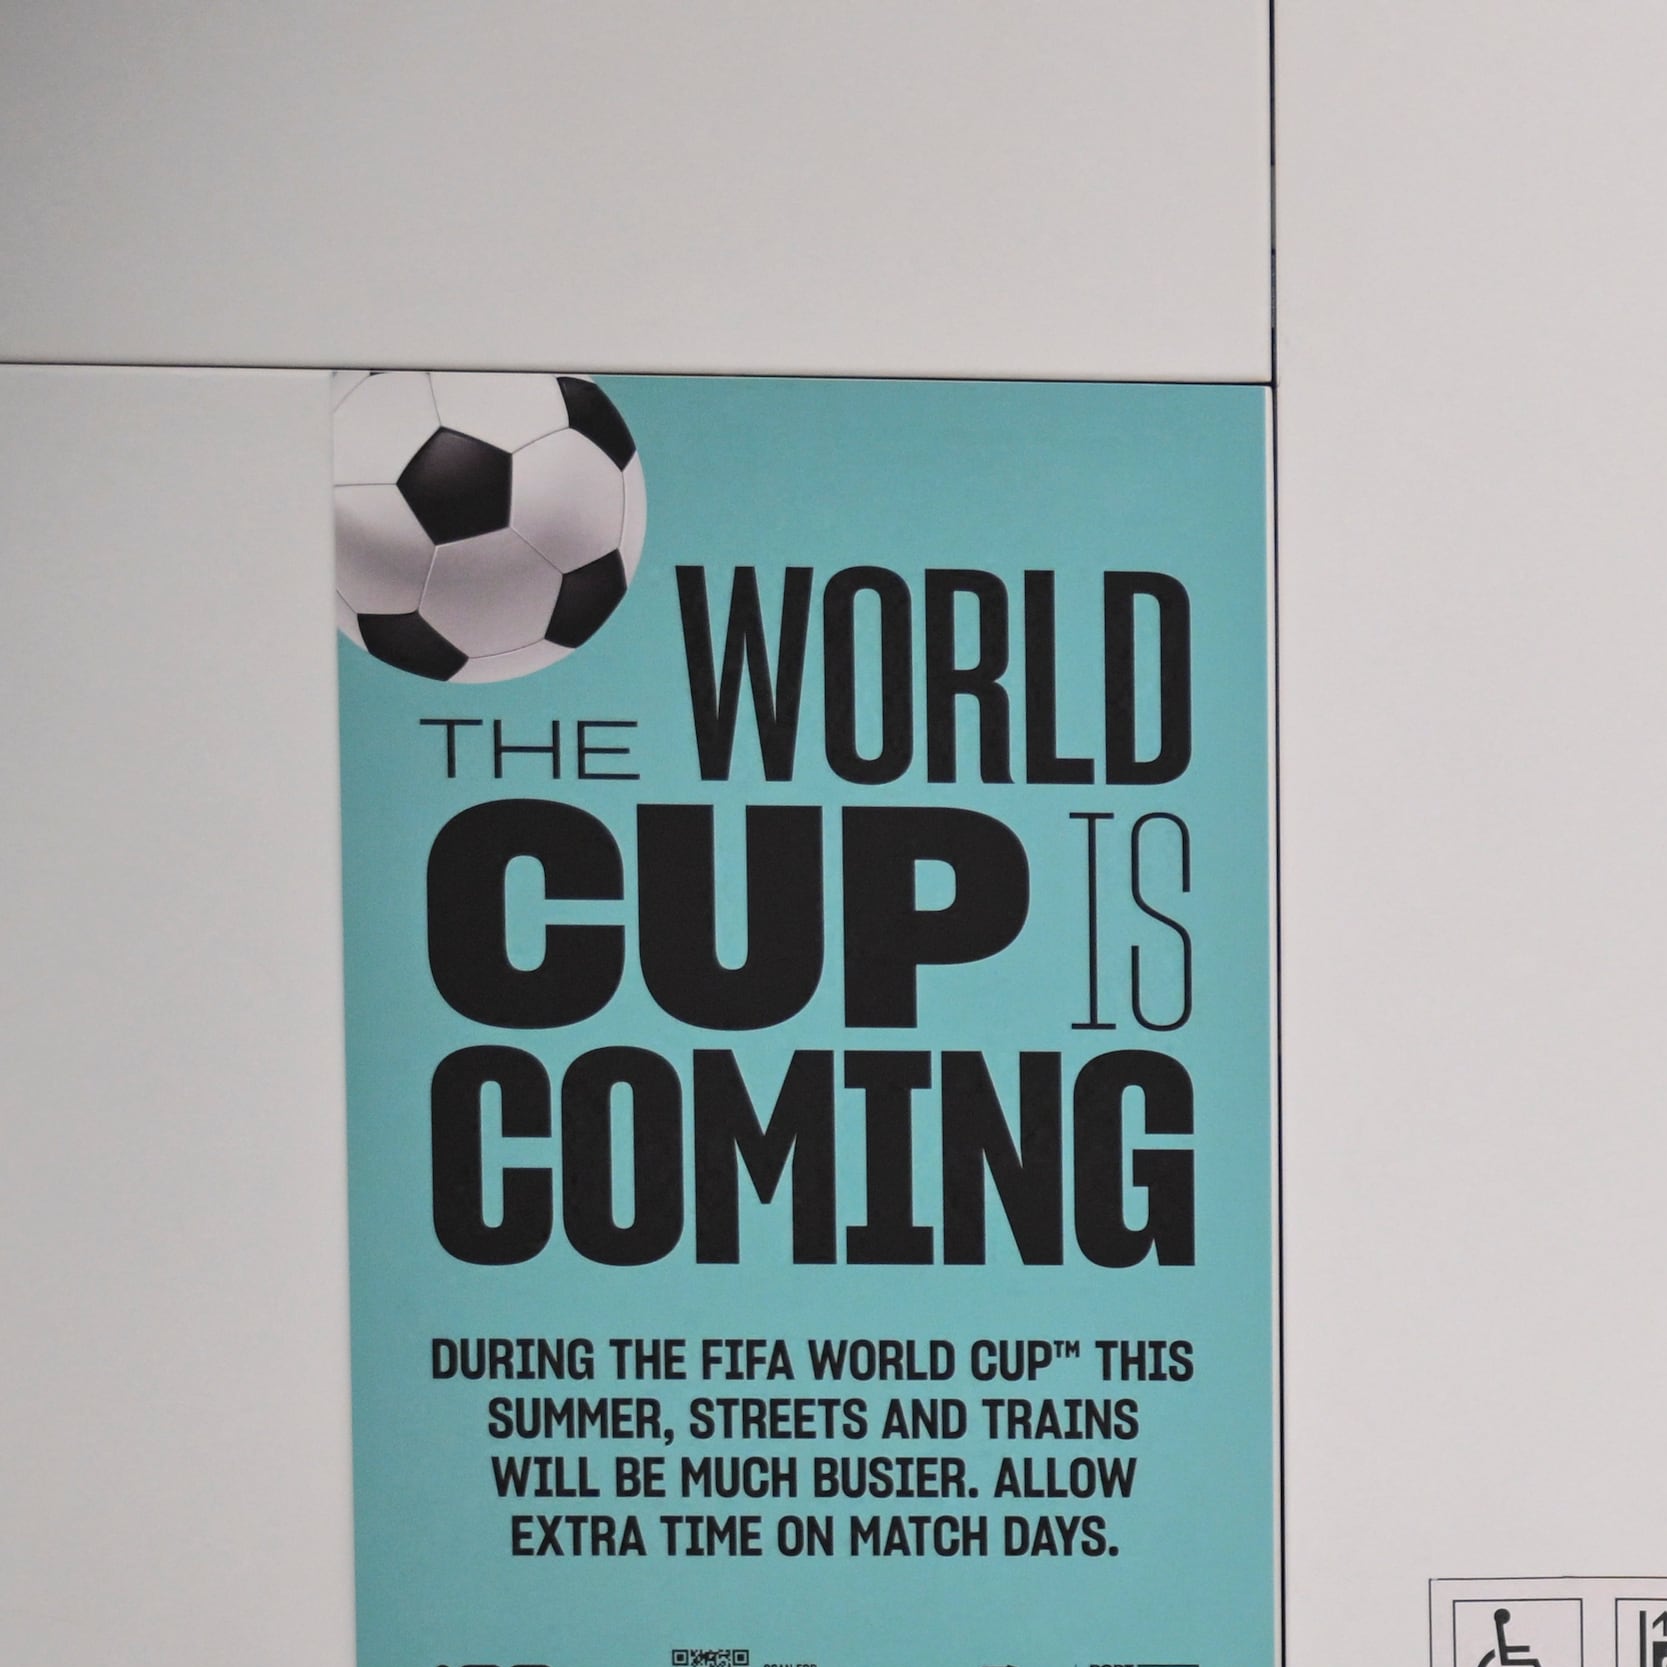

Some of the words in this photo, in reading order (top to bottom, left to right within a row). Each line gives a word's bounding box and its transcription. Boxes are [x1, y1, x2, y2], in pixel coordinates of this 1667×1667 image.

[419, 719, 640, 780] THE
[675, 565, 1191, 785] WORLD
[426, 799, 1029, 1031] CUP
[1069, 812, 1192, 1031] IS
[430, 1045, 1195, 1268] COMING
[432, 1338, 594, 1380] DURING
[609, 1339, 686, 1380] THE
[702, 1339, 794, 1380] FIFA
[808, 1339, 955, 1381] WORLD
[1095, 1340, 1193, 1381] THIS
[488, 1397, 674, 1446] SUMMER,
[690, 1398, 867, 1439] STREETS
[882, 1399, 966, 1439] AND
[982, 1399, 1138, 1440] TRAINS
[491, 1456, 600, 1497] WILL
[616, 1457, 665, 1497] BE
[681, 1457, 797, 1498] MUCH
[814, 1457, 978, 1498] BUSIER.
[994, 1457, 1137, 1498] ALLOW
[512, 1515, 647, 1556] EXTRA
[660, 1516, 762, 1556] TIME
[778, 1516, 833, 1556] ON
[850, 1516, 987, 1556] MATCH
[1004, 1516, 1118, 1556] DAYS.
